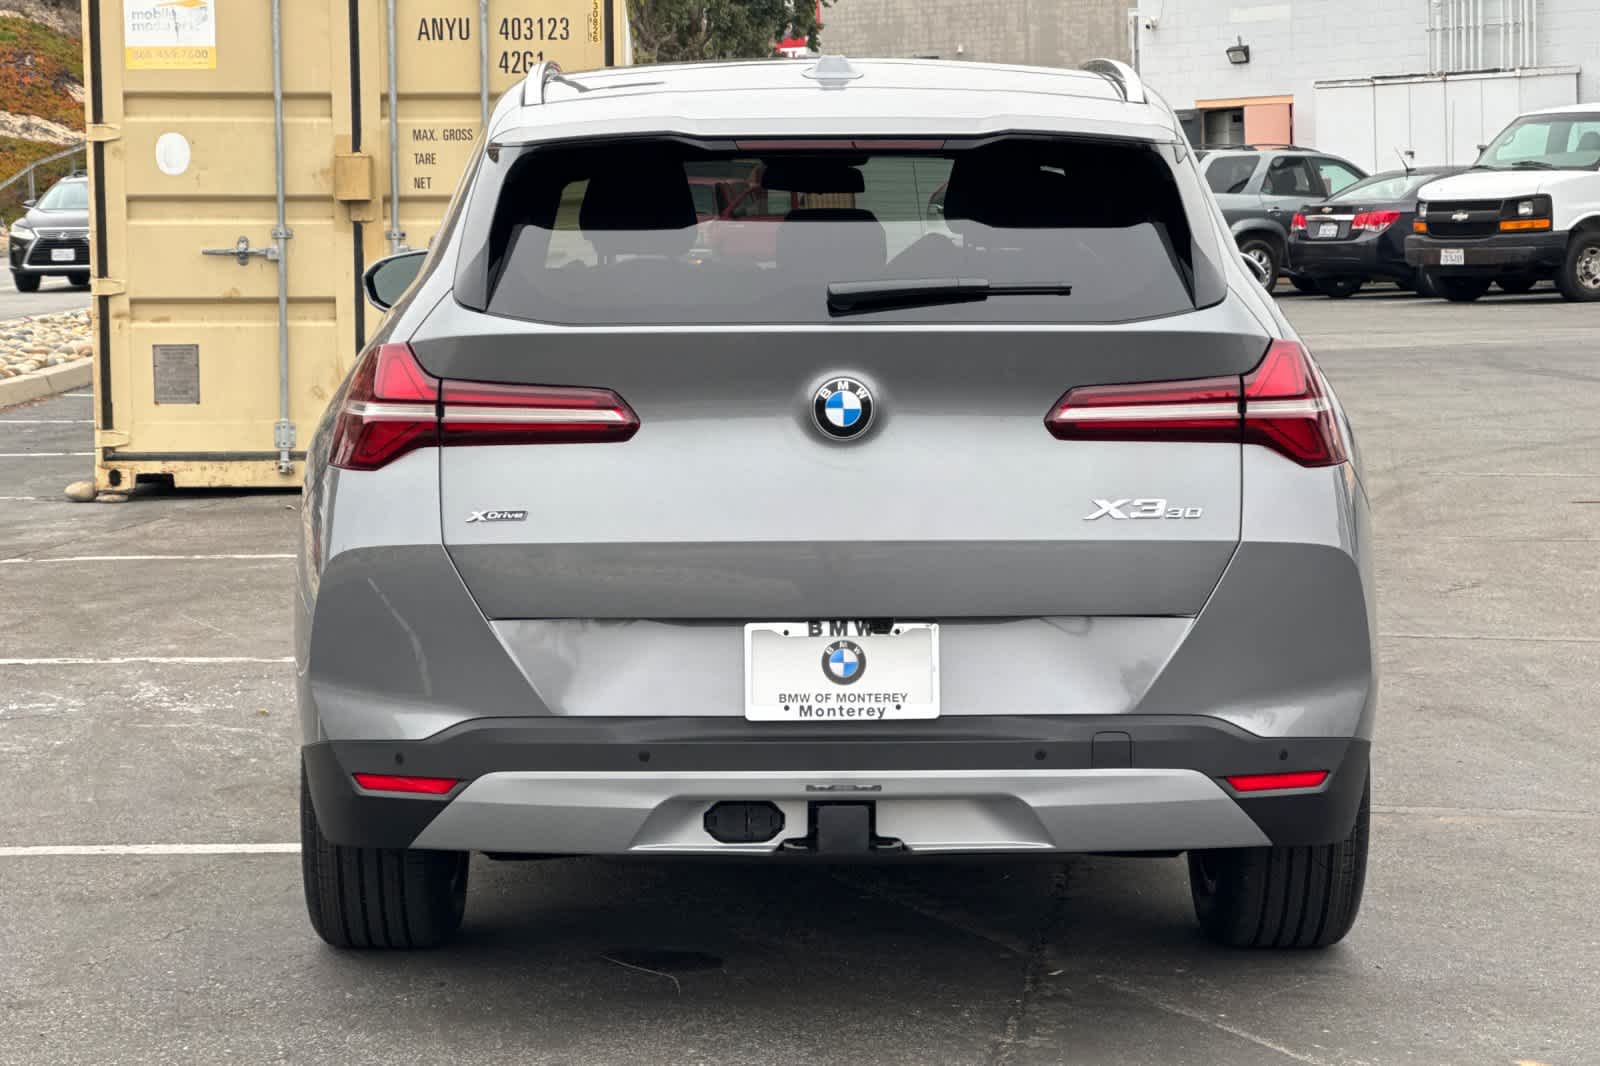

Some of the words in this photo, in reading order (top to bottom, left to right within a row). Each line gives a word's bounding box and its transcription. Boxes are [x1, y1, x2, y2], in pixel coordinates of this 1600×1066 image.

[417, 17, 470, 41] ANYU
[499, 17, 570, 41] 403123
[412, 128, 438, 142] MAX.
[442, 128, 473, 141] GROSS
[414, 152, 437, 165] TARE
[414, 176, 432, 189] NET
[820, 381, 869, 399] BMW
[807, 621, 872, 637] BMW
[825, 641, 861, 655] BMW
[778, 693, 811, 703] BMW
[814, 693, 832, 703] OF
[835, 692, 909, 703] MONTEREY
[799, 704, 886, 719] Monterey
